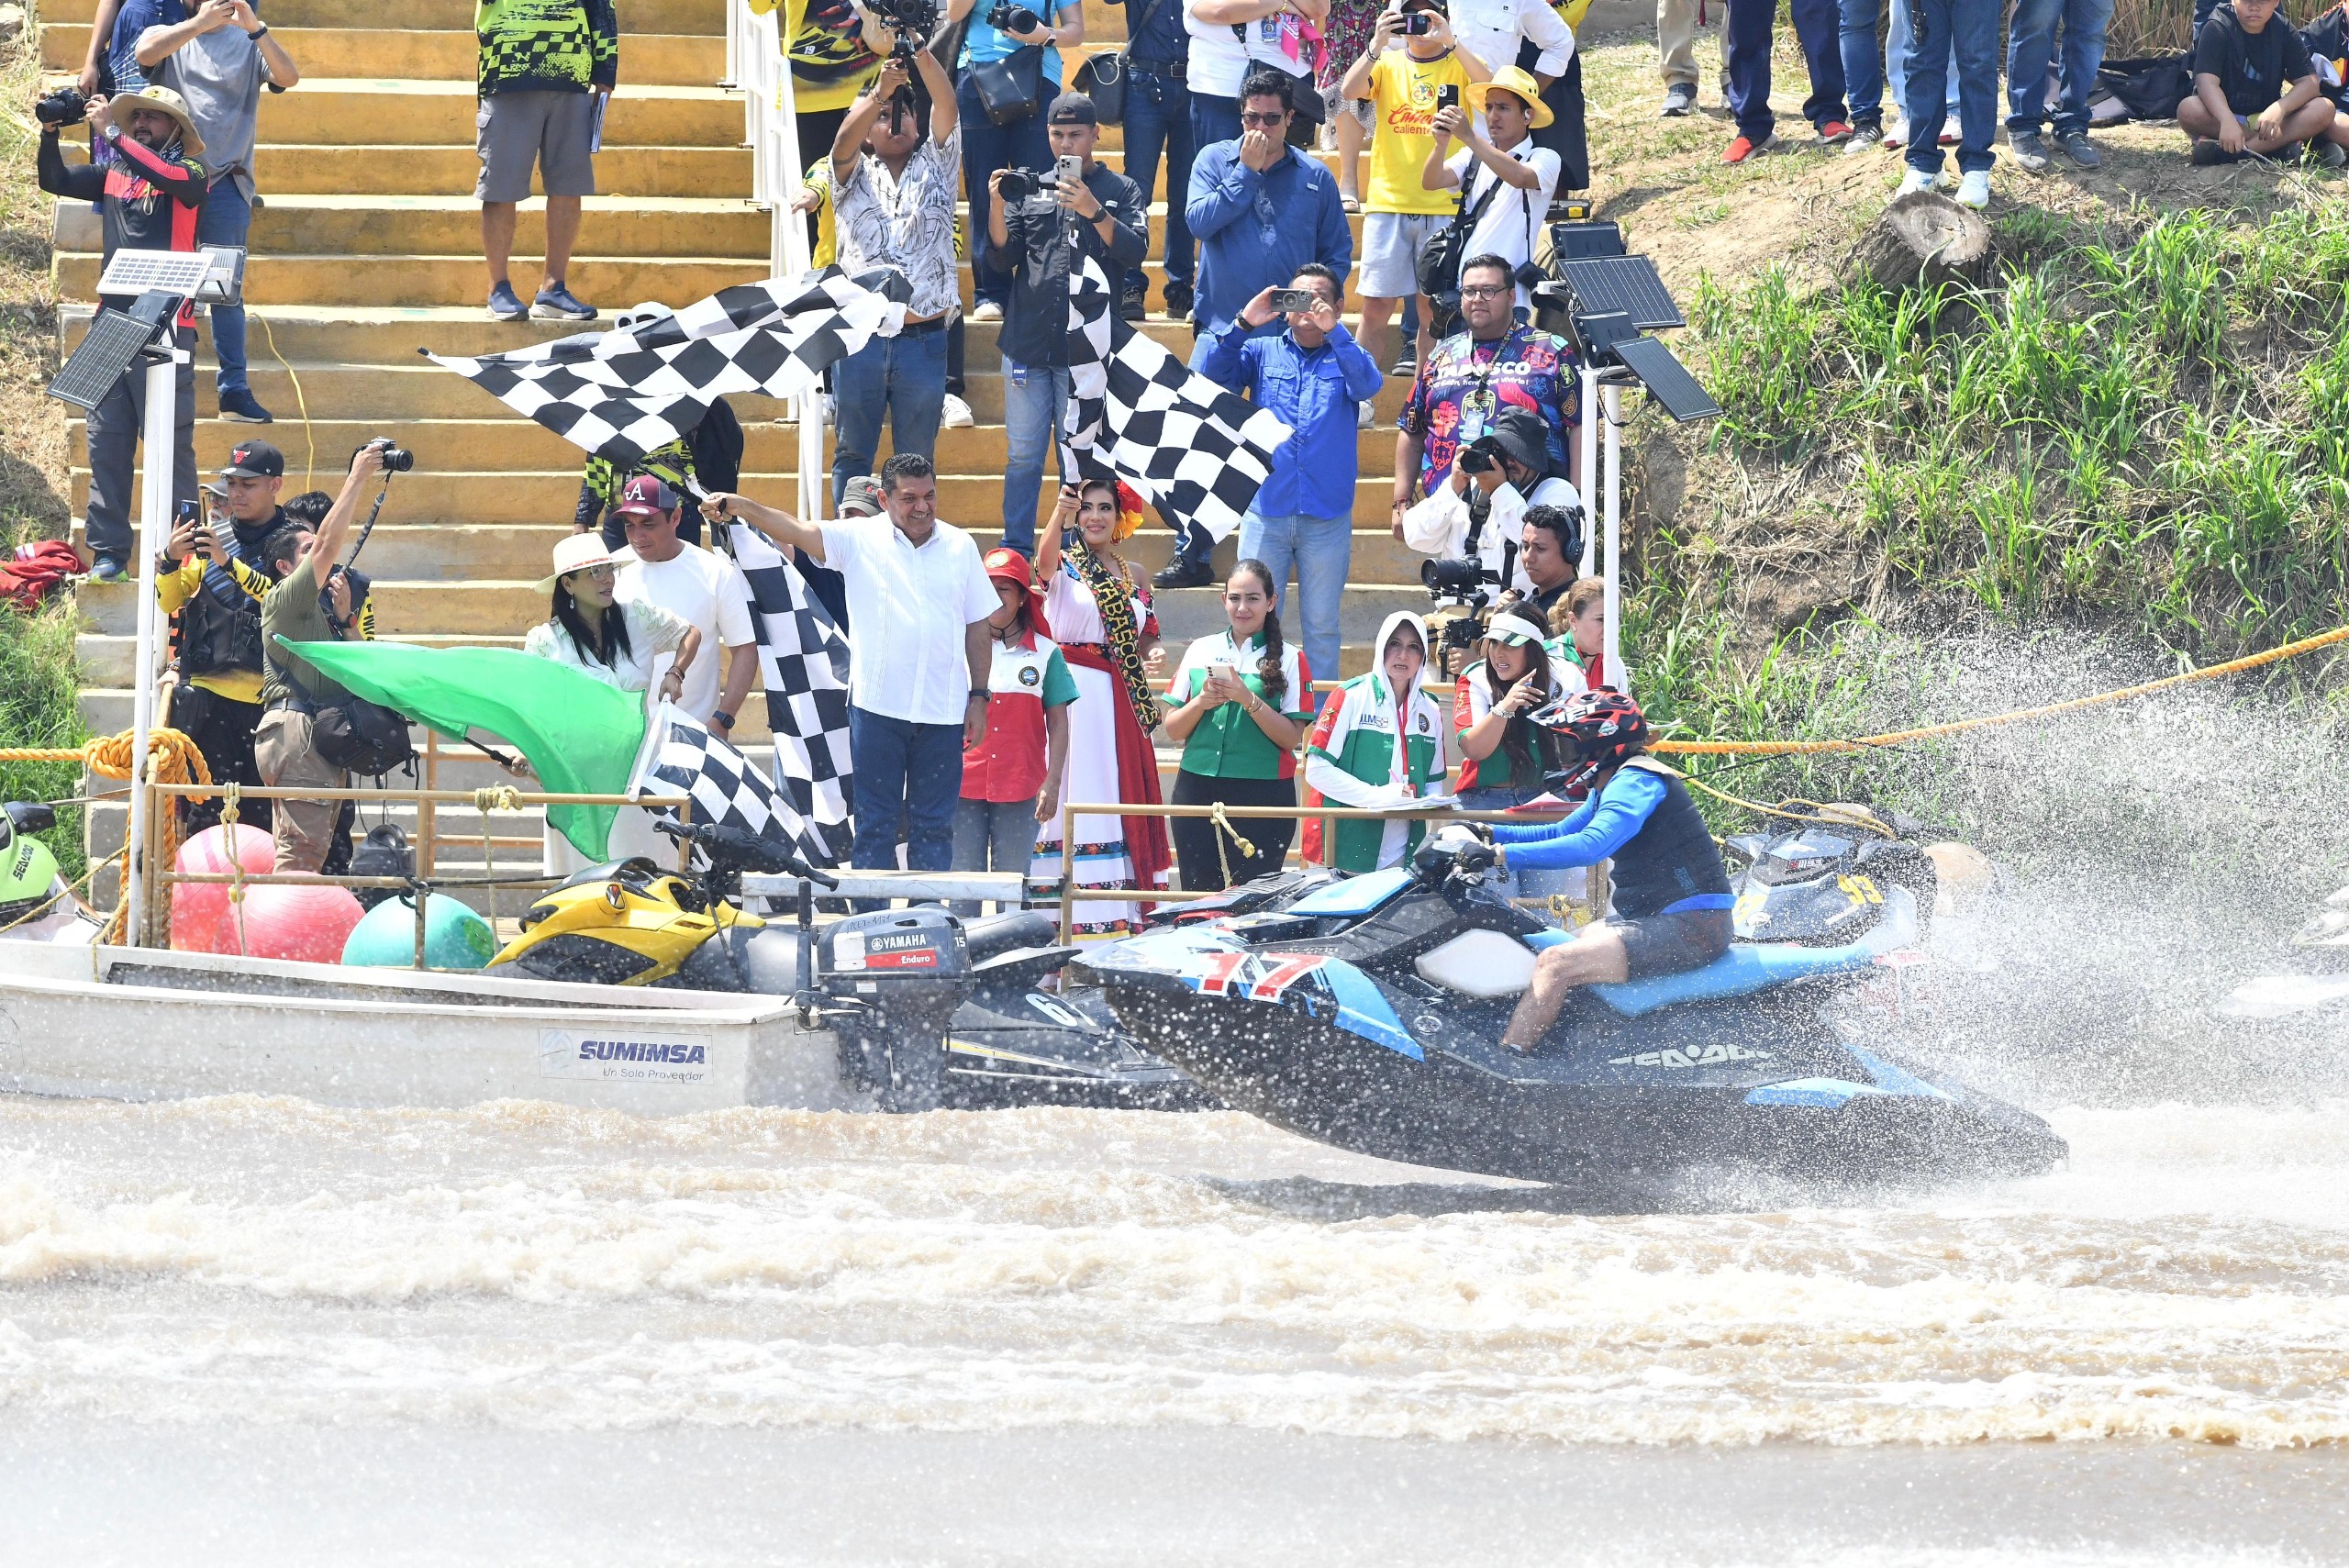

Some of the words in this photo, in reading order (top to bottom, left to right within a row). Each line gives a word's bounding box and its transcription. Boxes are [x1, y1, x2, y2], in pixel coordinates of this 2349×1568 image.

[804, 45, 816, 55] 19
[1095, 576, 1140, 670] TABASCO
[1130, 670, 1159, 726] 2025
[1837, 874, 1884, 905] 93
[885, 934, 927, 949] YAMAHA
[954, 936, 966, 948] 15
[900, 955, 931, 964] Enduro
[579, 1040, 706, 1064] SUMIMSA
[603, 1067, 618, 1077] Un
[620, 1068, 644, 1078] Solo
